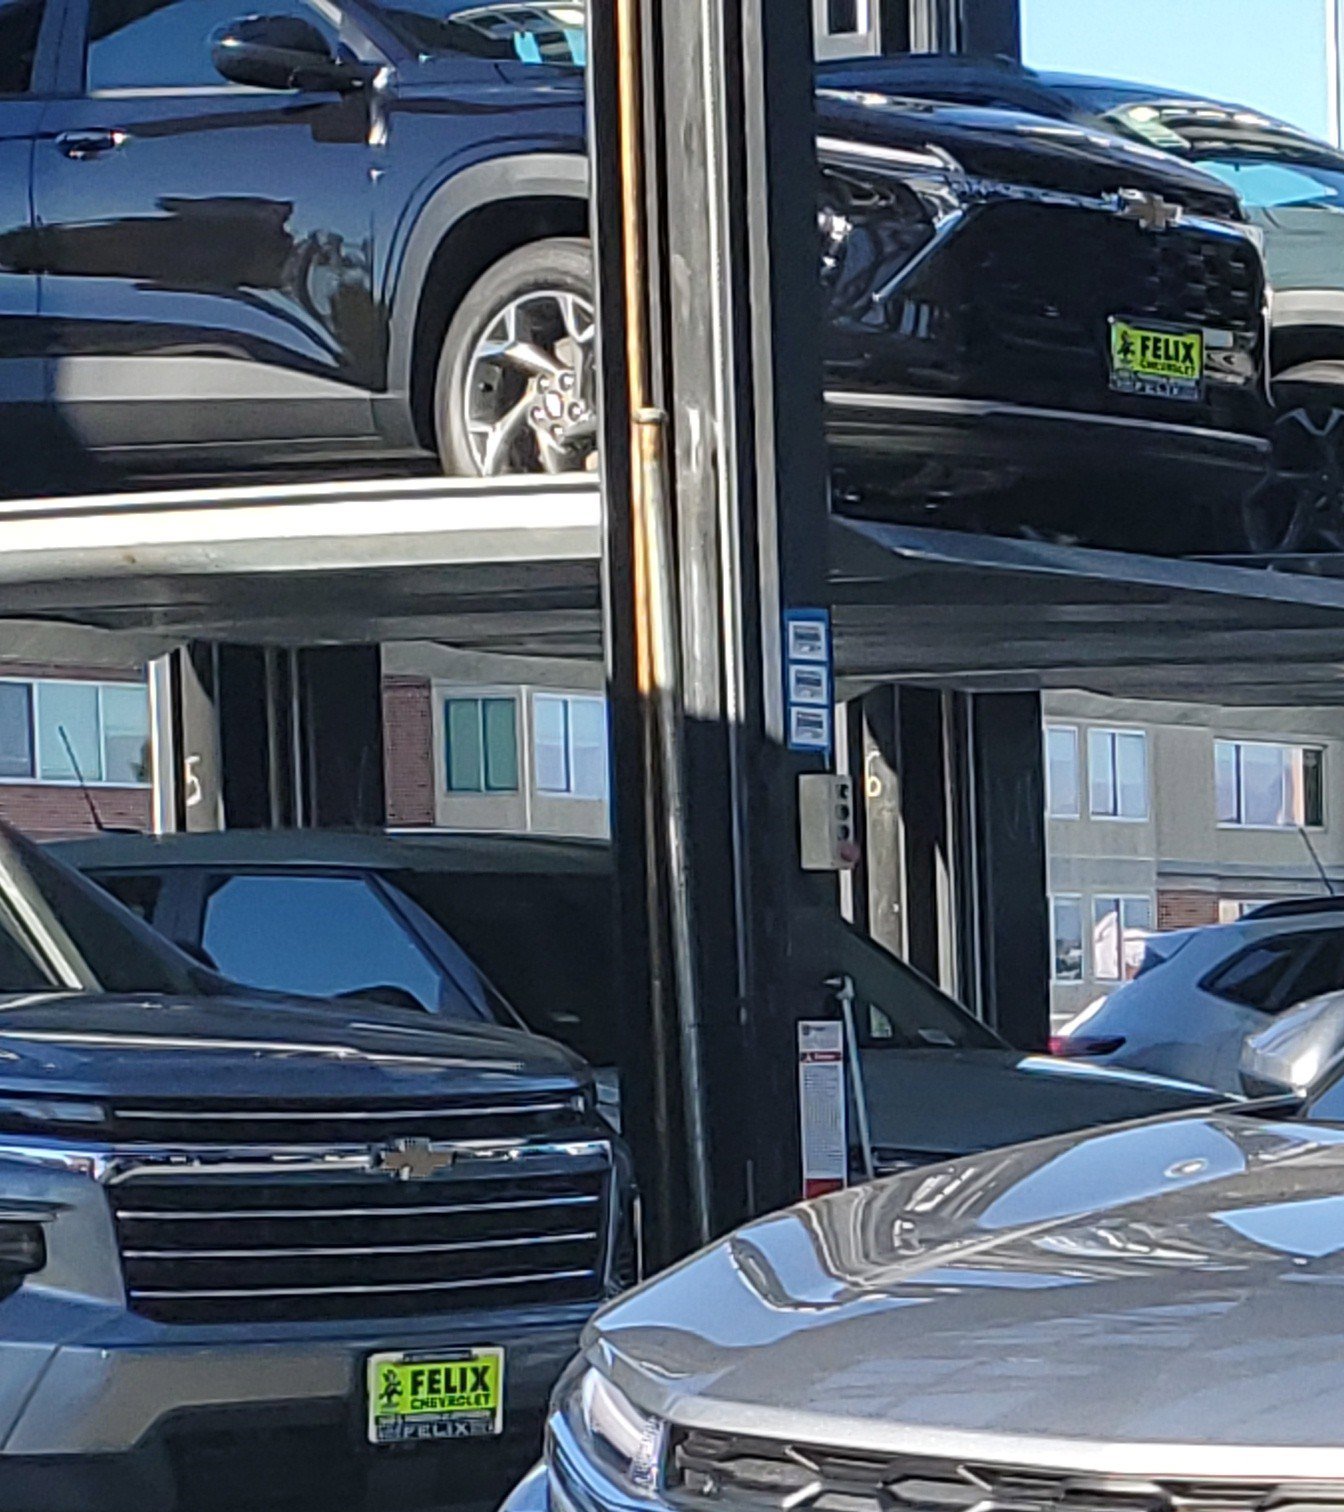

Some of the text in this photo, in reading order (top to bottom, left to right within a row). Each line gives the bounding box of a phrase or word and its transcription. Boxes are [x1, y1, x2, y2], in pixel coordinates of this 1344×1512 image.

[1140, 335, 1195, 365] FELIX
[185, 755, 202, 807] 5
[864, 750, 882, 797] 6
[410, 1365, 490, 1396] FELIX
[402, 1421, 471, 1439] FELIX
